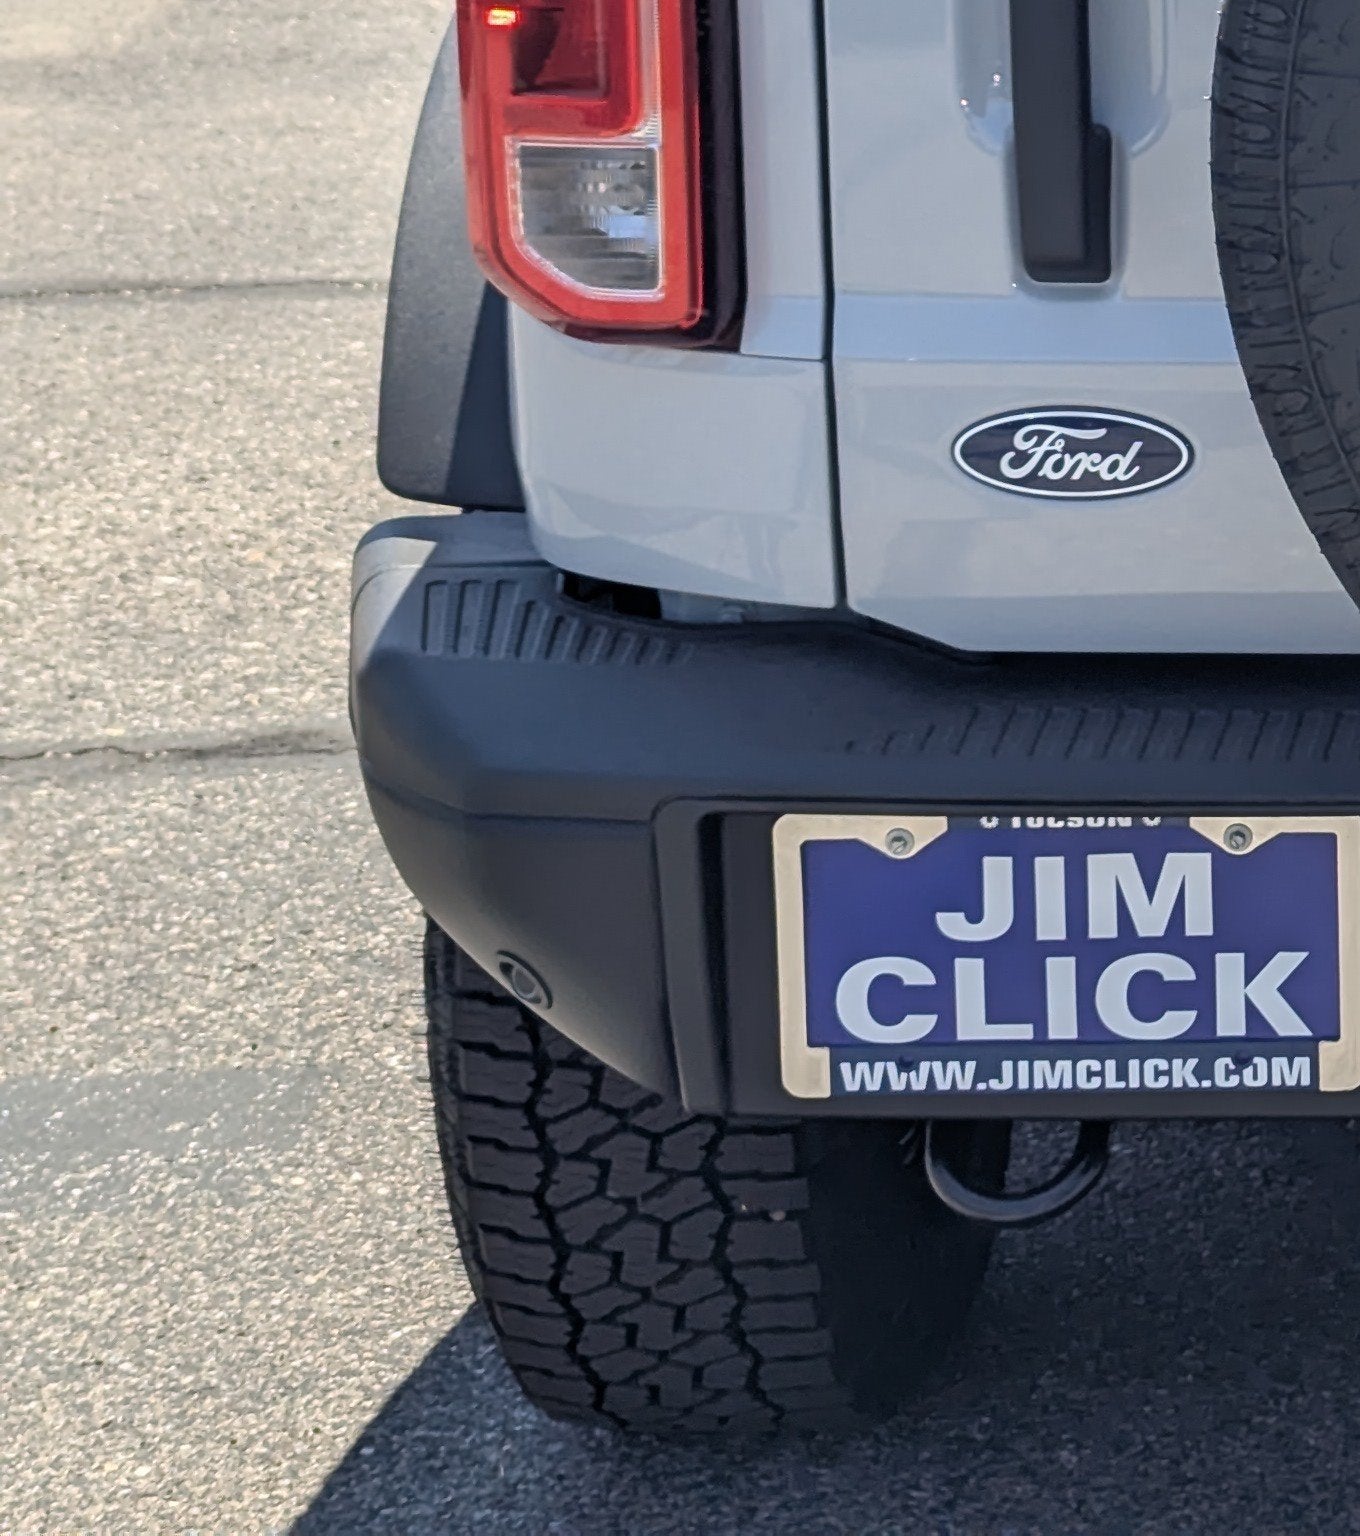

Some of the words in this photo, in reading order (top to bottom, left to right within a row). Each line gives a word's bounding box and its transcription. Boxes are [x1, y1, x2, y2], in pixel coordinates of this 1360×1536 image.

[1000, 422, 1142, 483] Ford
[935, 851, 1214, 942] JIM
[835, 950, 1314, 1044] CLICK
[838, 1055, 1312, 1093] WWW.JIMCLICK.COM
